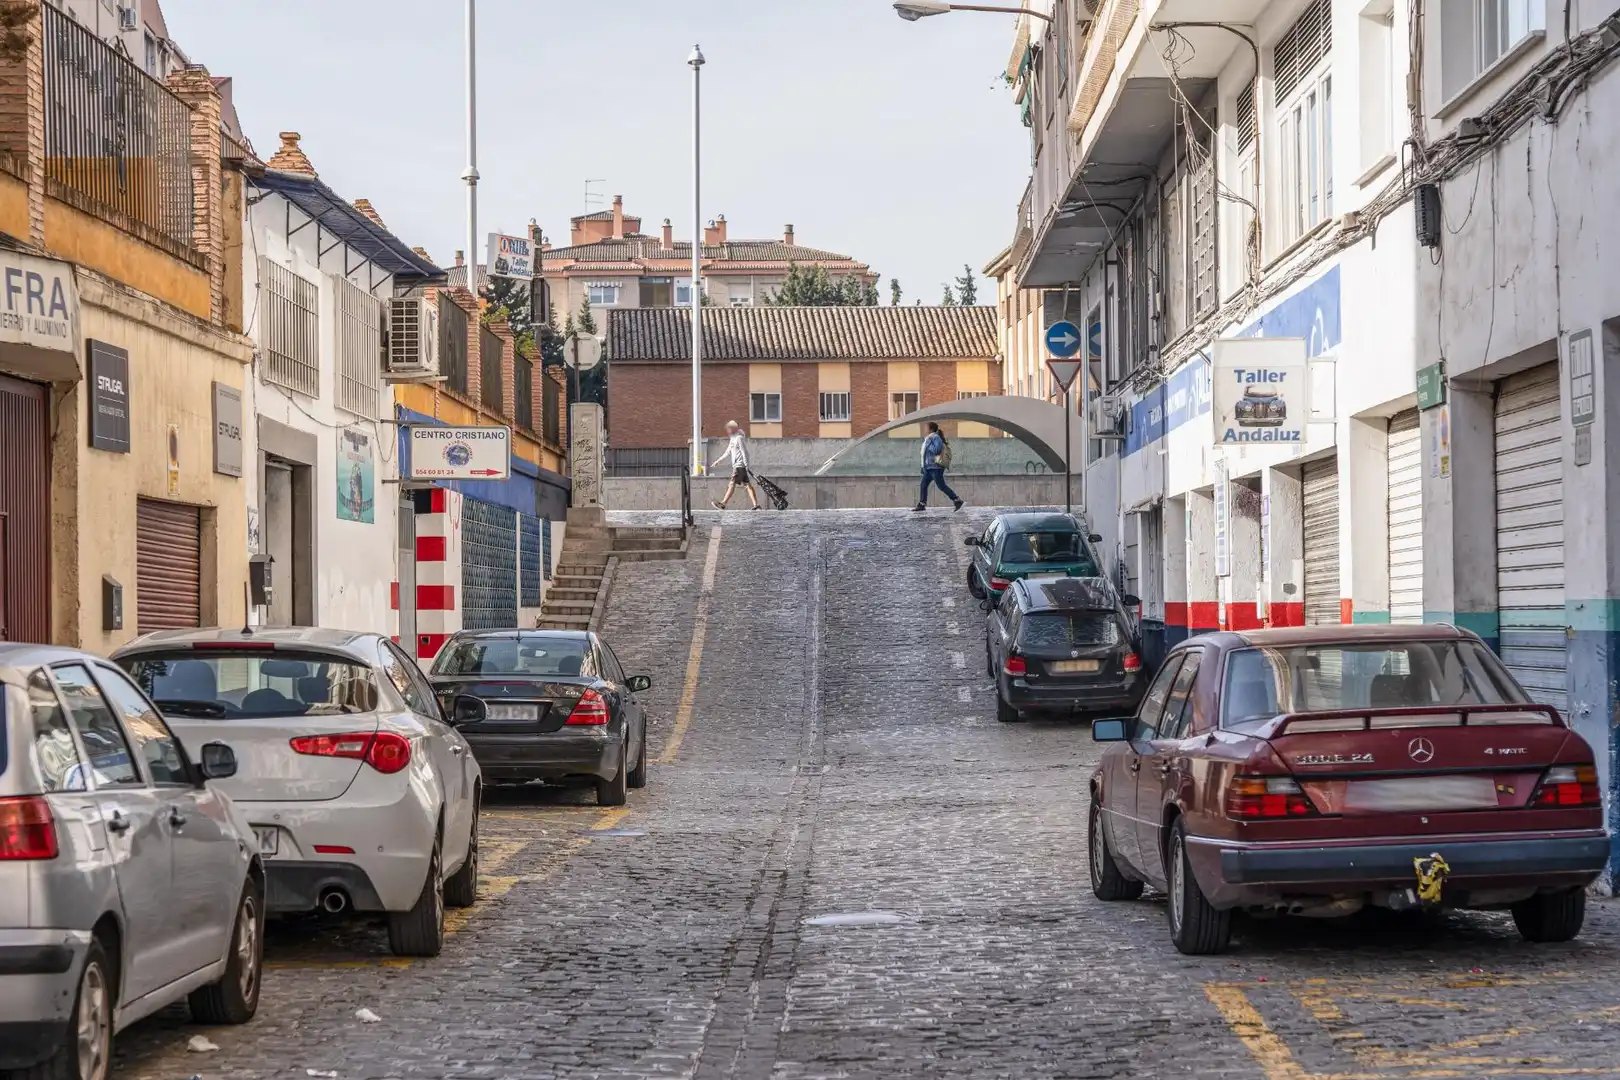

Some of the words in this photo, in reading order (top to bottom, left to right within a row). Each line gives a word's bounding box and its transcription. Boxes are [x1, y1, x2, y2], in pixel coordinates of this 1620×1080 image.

[5, 266, 69, 320] FRA
[1233, 369, 1287, 384] Taller
[414, 430, 453, 440] CENTRO
[455, 430, 506, 440] CRISTIANO
[1223, 428, 1300, 442] Andaluz
[1483, 747, 1494, 755] 4
